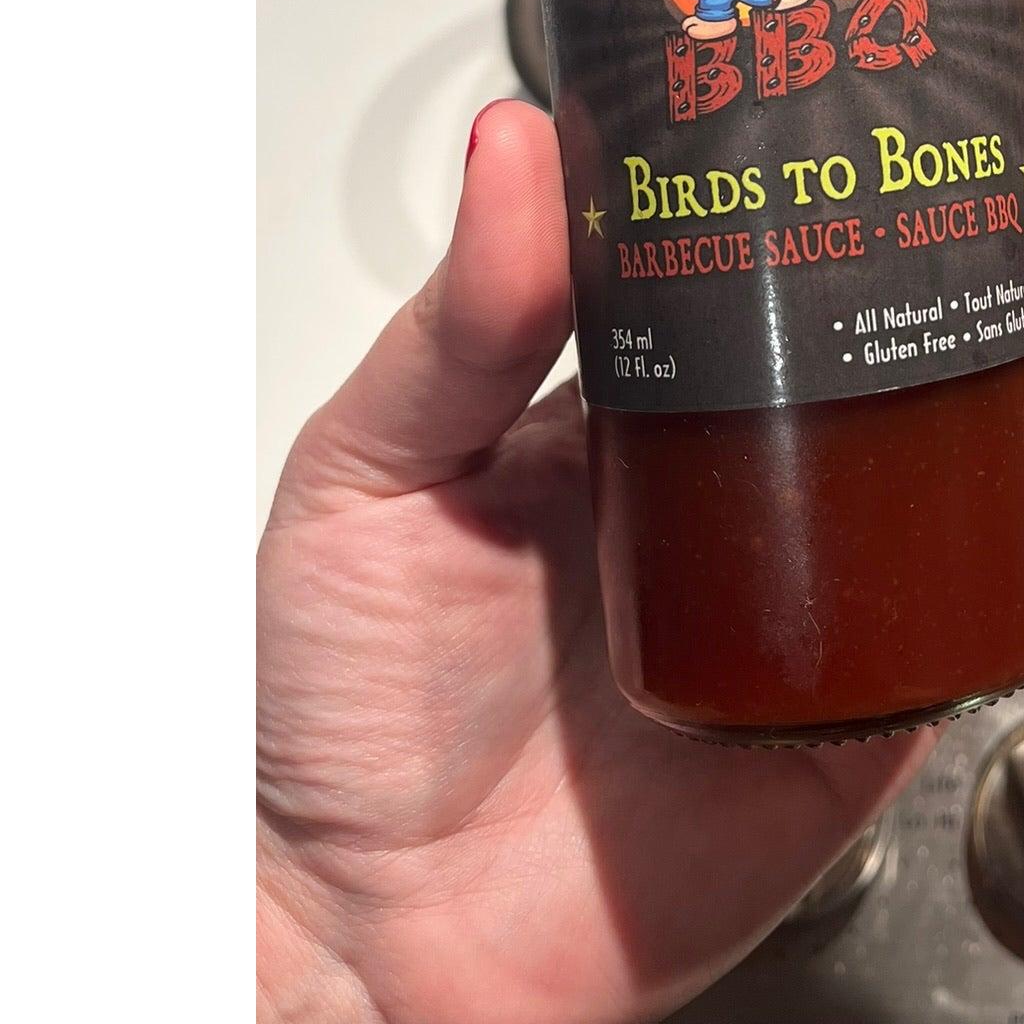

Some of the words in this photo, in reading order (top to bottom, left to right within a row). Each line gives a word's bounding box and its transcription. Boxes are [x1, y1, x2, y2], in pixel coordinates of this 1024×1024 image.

[617, 232, 754, 279] BARBECUE
[764, 218, 865, 267] SAUCE
[897, 200, 979, 249] SAUCE
[984, 192, 1023, 234] BBQ
[855, 307, 877, 335] All
[883, 296, 943, 330] Natural
[964, 285, 992, 314] Tout
[611, 328, 632, 350] 354
[636, 327, 653, 350] ml
[864, 337, 918, 365] Gluten
[923, 332, 956, 354] Free
[977, 320, 1002, 342] Sans
[615, 355, 632, 378] (12
[654, 354, 676, 379] oz)
